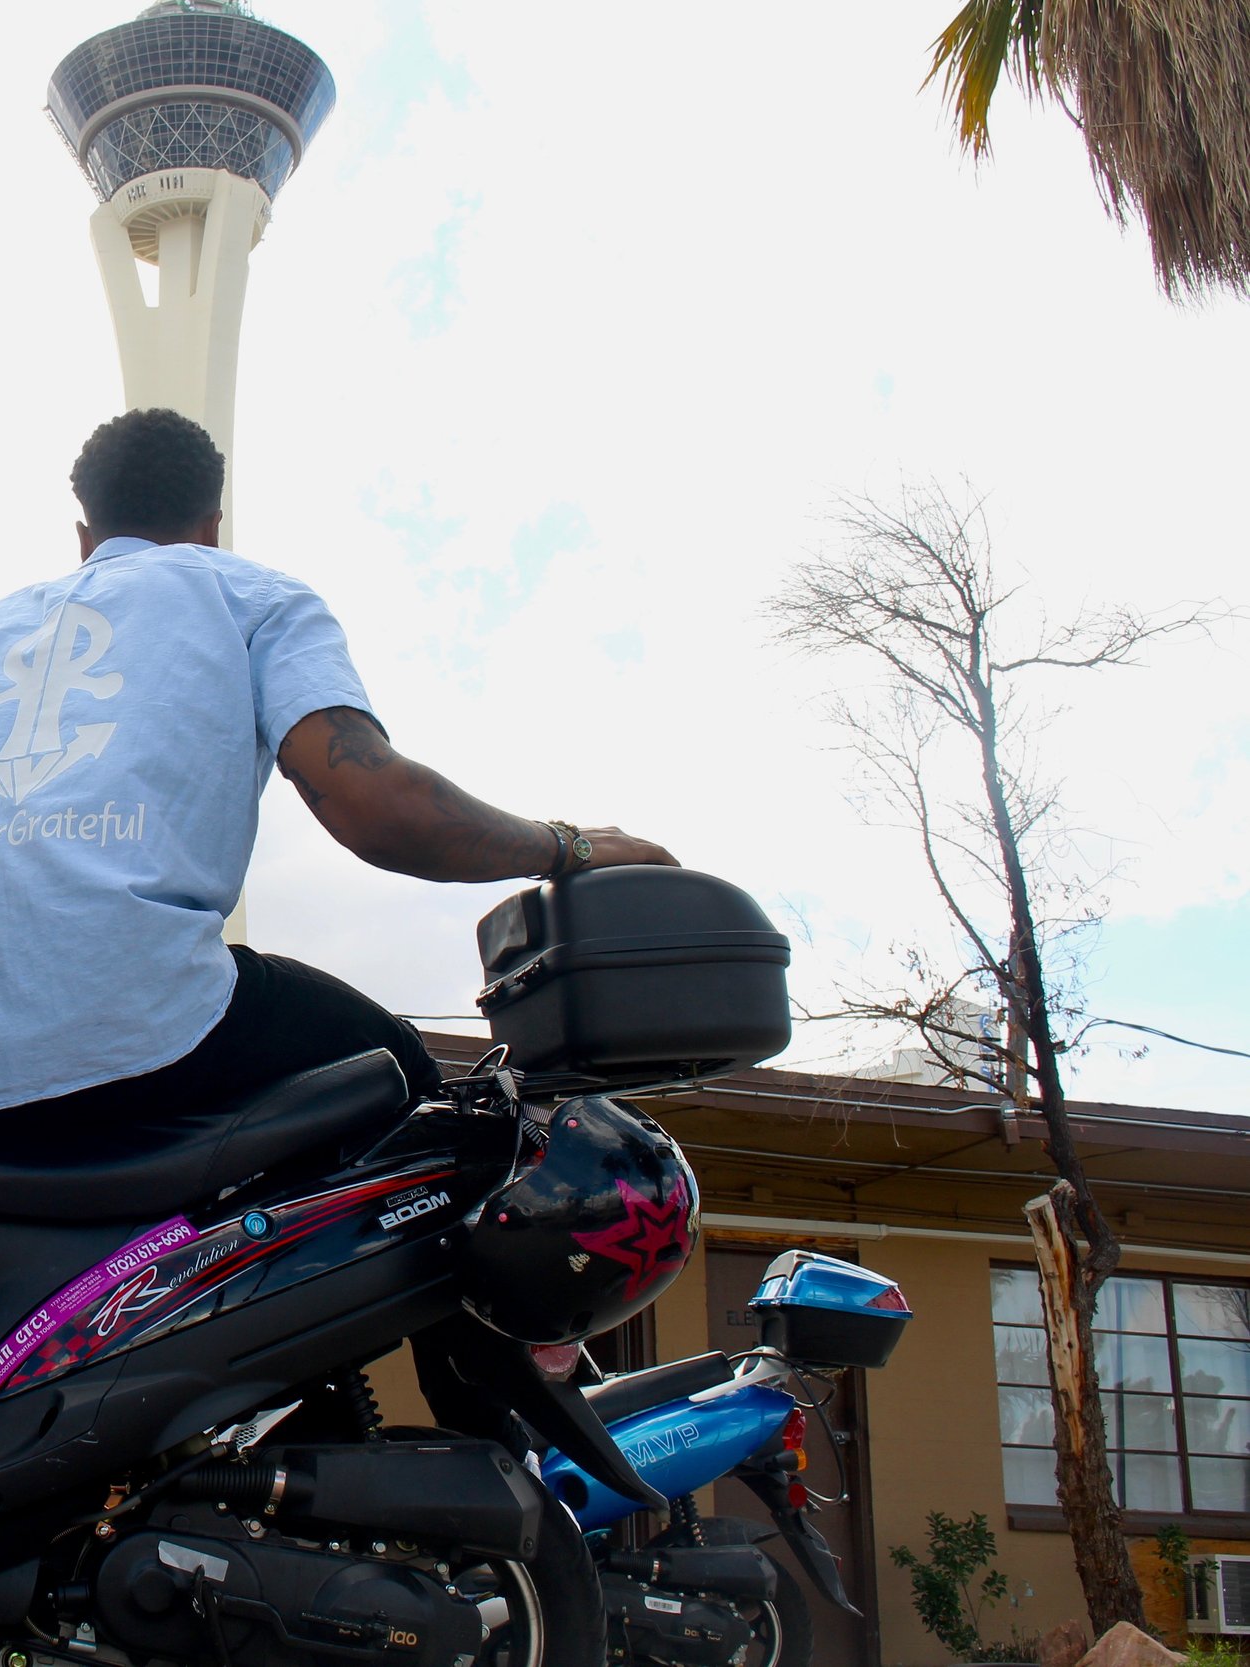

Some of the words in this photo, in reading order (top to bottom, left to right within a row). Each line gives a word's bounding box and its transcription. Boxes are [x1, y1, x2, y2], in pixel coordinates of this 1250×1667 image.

[378, 1191, 451, 1231] BOOM
[106, 1252, 140, 1277] (702)
[138, 1225, 191, 1259] 678-6099
[57, 1301, 67, 1309] Las
[69, 1281, 83, 1292] Vegas
[15, 1309, 50, 1344] CITY
[15, 1338, 37, 1358] RENTALS
[39, 1320, 57, 1335] TOURS
[621, 1422, 700, 1471] MVP
